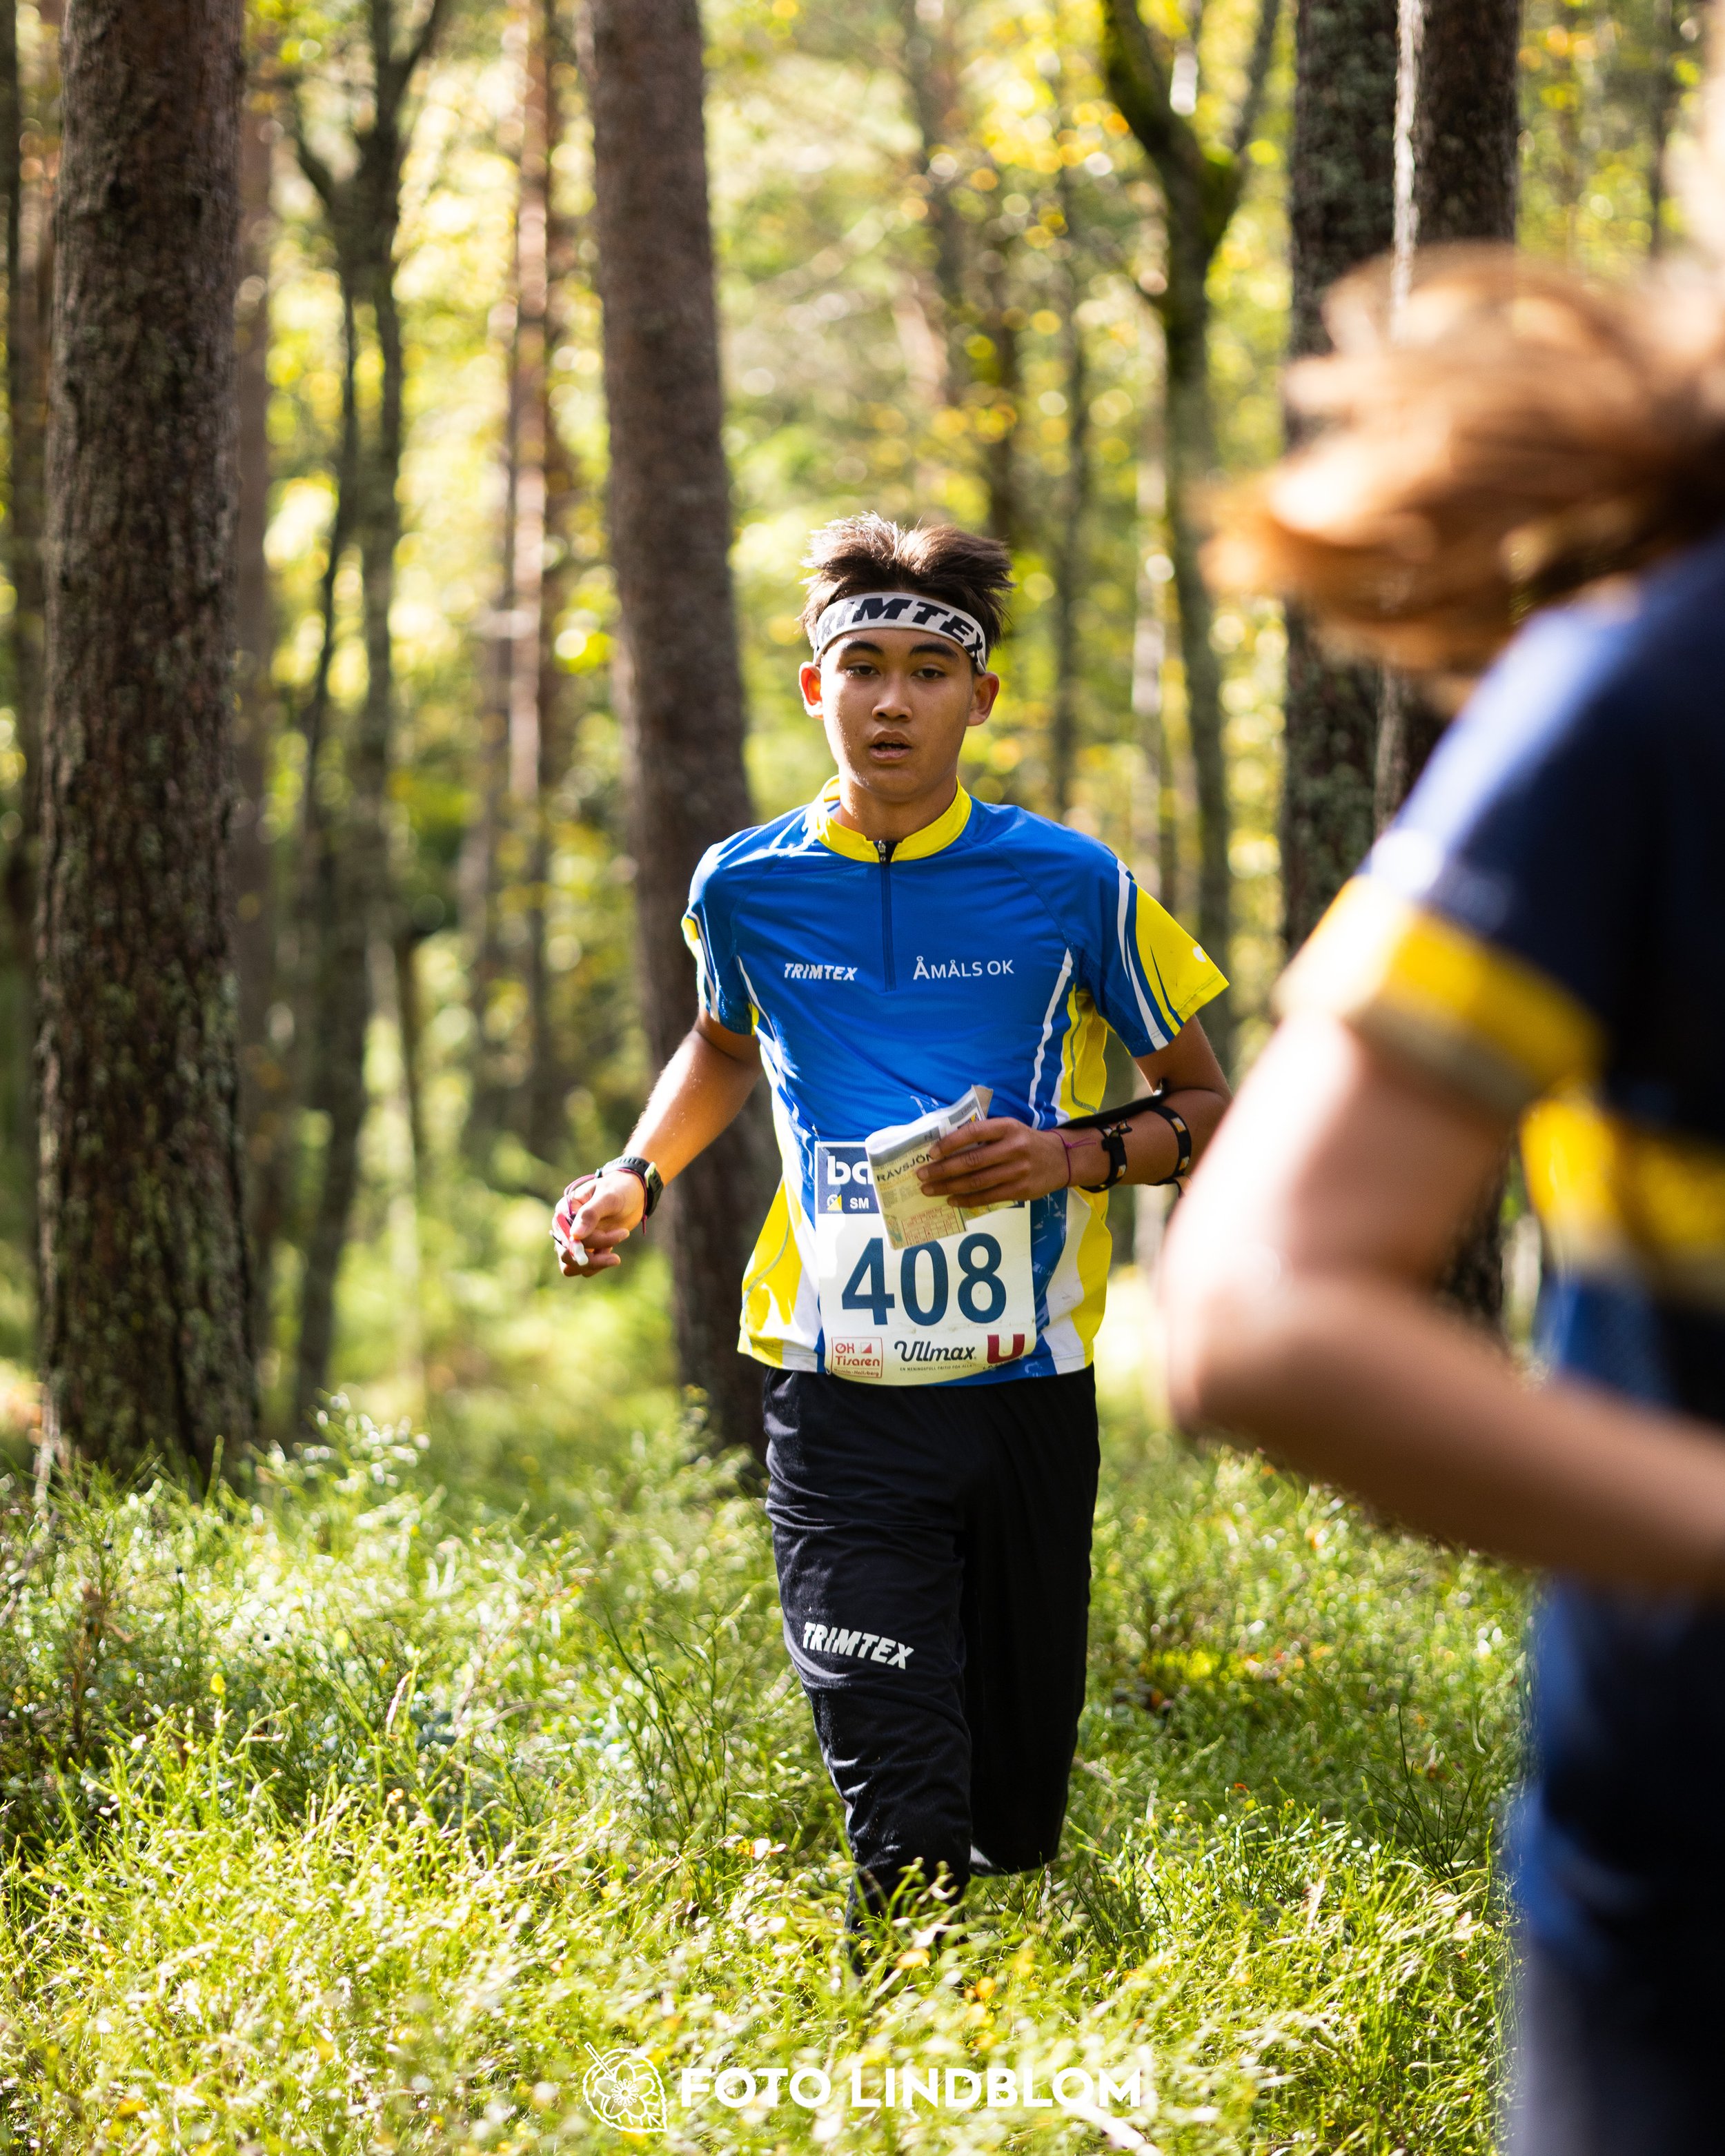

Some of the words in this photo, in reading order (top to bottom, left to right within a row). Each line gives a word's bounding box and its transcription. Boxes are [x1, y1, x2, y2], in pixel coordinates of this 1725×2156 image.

[784, 962, 858, 981] TRIMTEX
[913, 956, 983, 980] ÅMÅLS
[987, 959, 1015, 976] OK
[849, 1197, 869, 1209] SM
[841, 1232, 1007, 1326] 408
[835, 1355, 880, 1367] Tisaren
[894, 1341, 976, 1363] Ullmax
[802, 1621, 914, 1670] TRIMTEX
